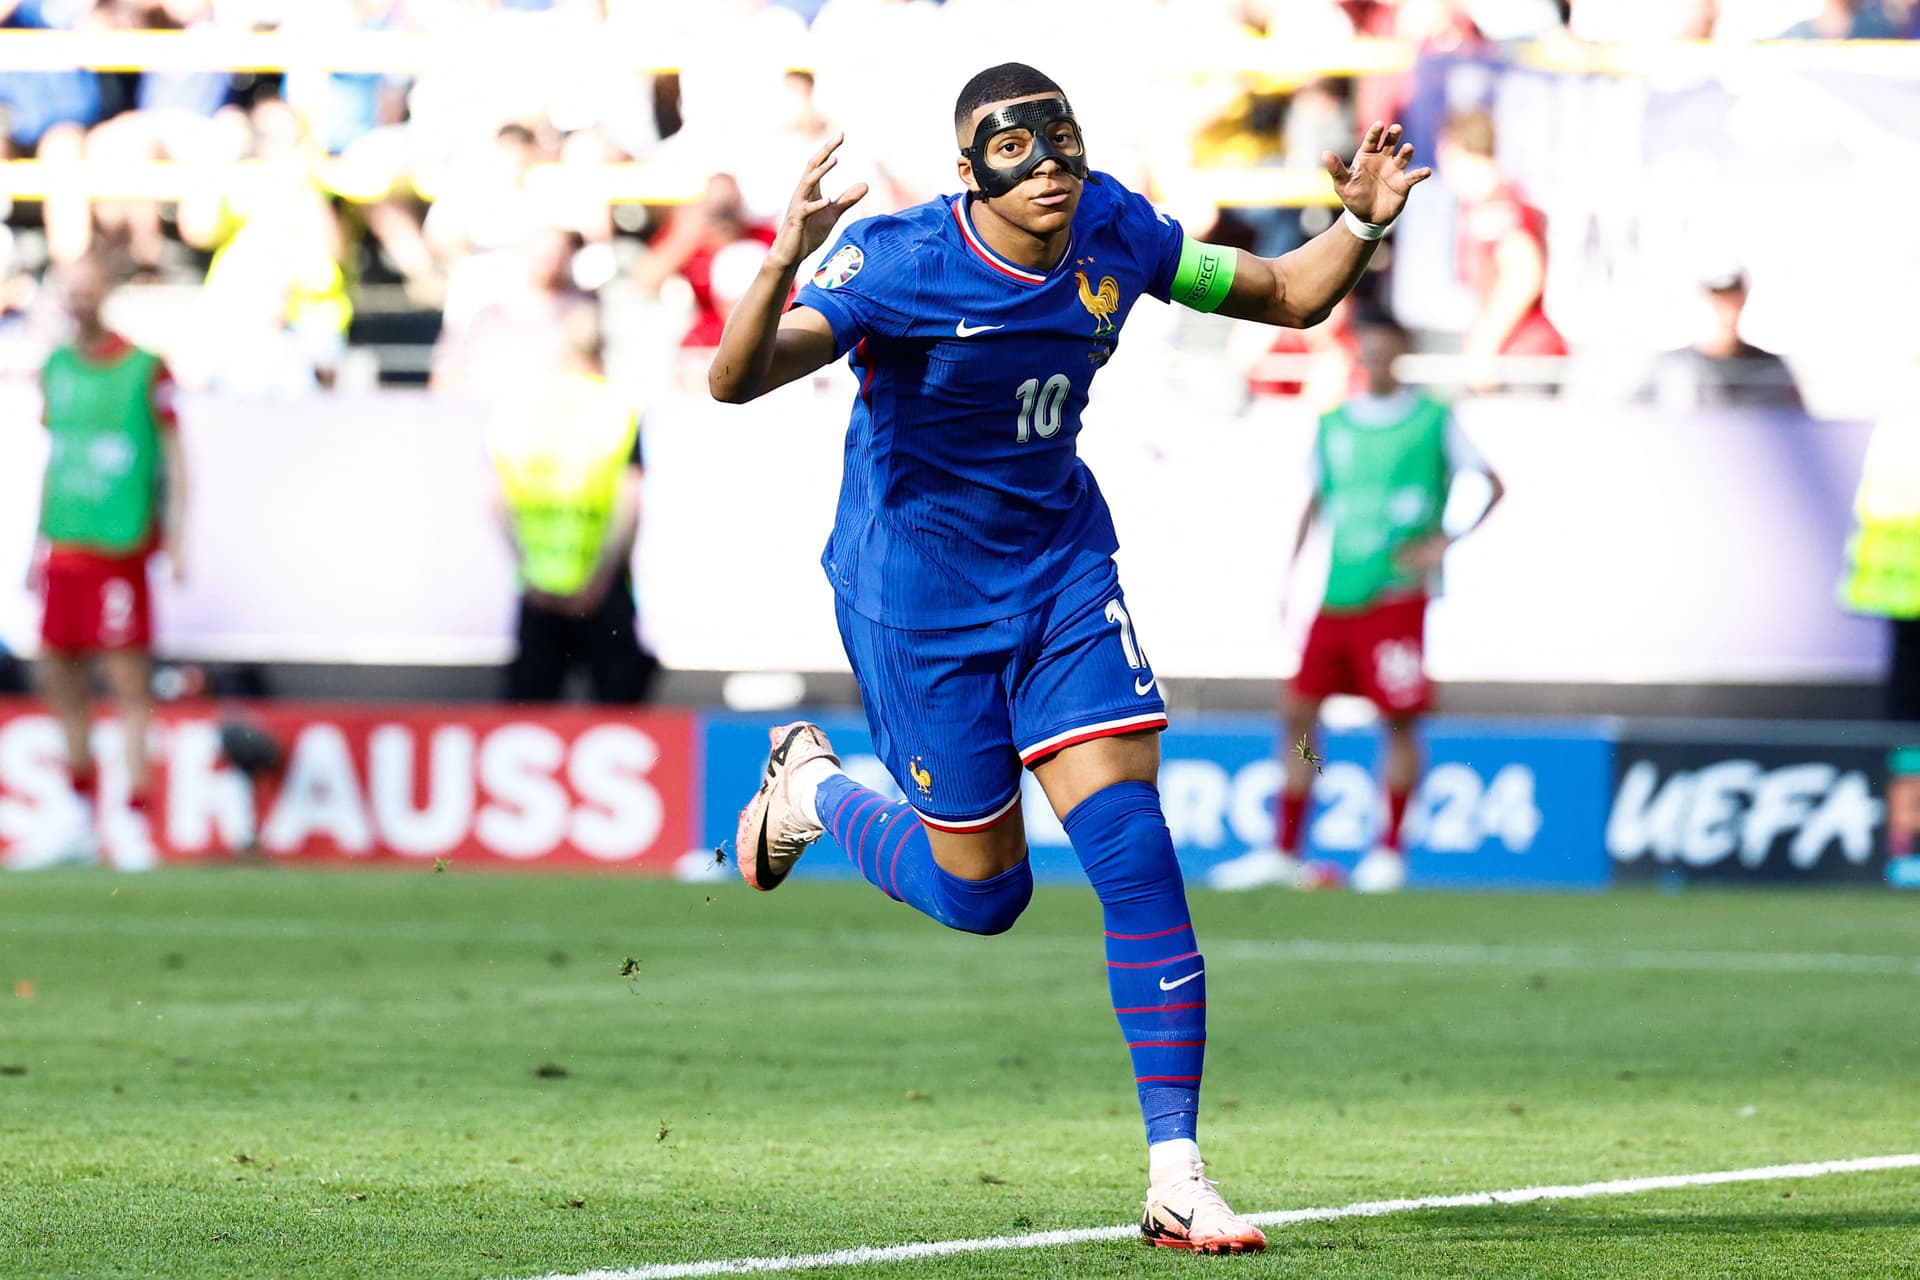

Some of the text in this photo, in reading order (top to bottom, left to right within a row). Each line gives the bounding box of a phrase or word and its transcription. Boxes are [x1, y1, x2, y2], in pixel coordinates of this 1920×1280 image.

[1187, 254, 1217, 302] RESPECT
[1015, 373, 1071, 443] 10
[1103, 598, 1147, 669] 1
[1022, 758, 1543, 854] RO224
[1606, 759, 1885, 868] UEFA
